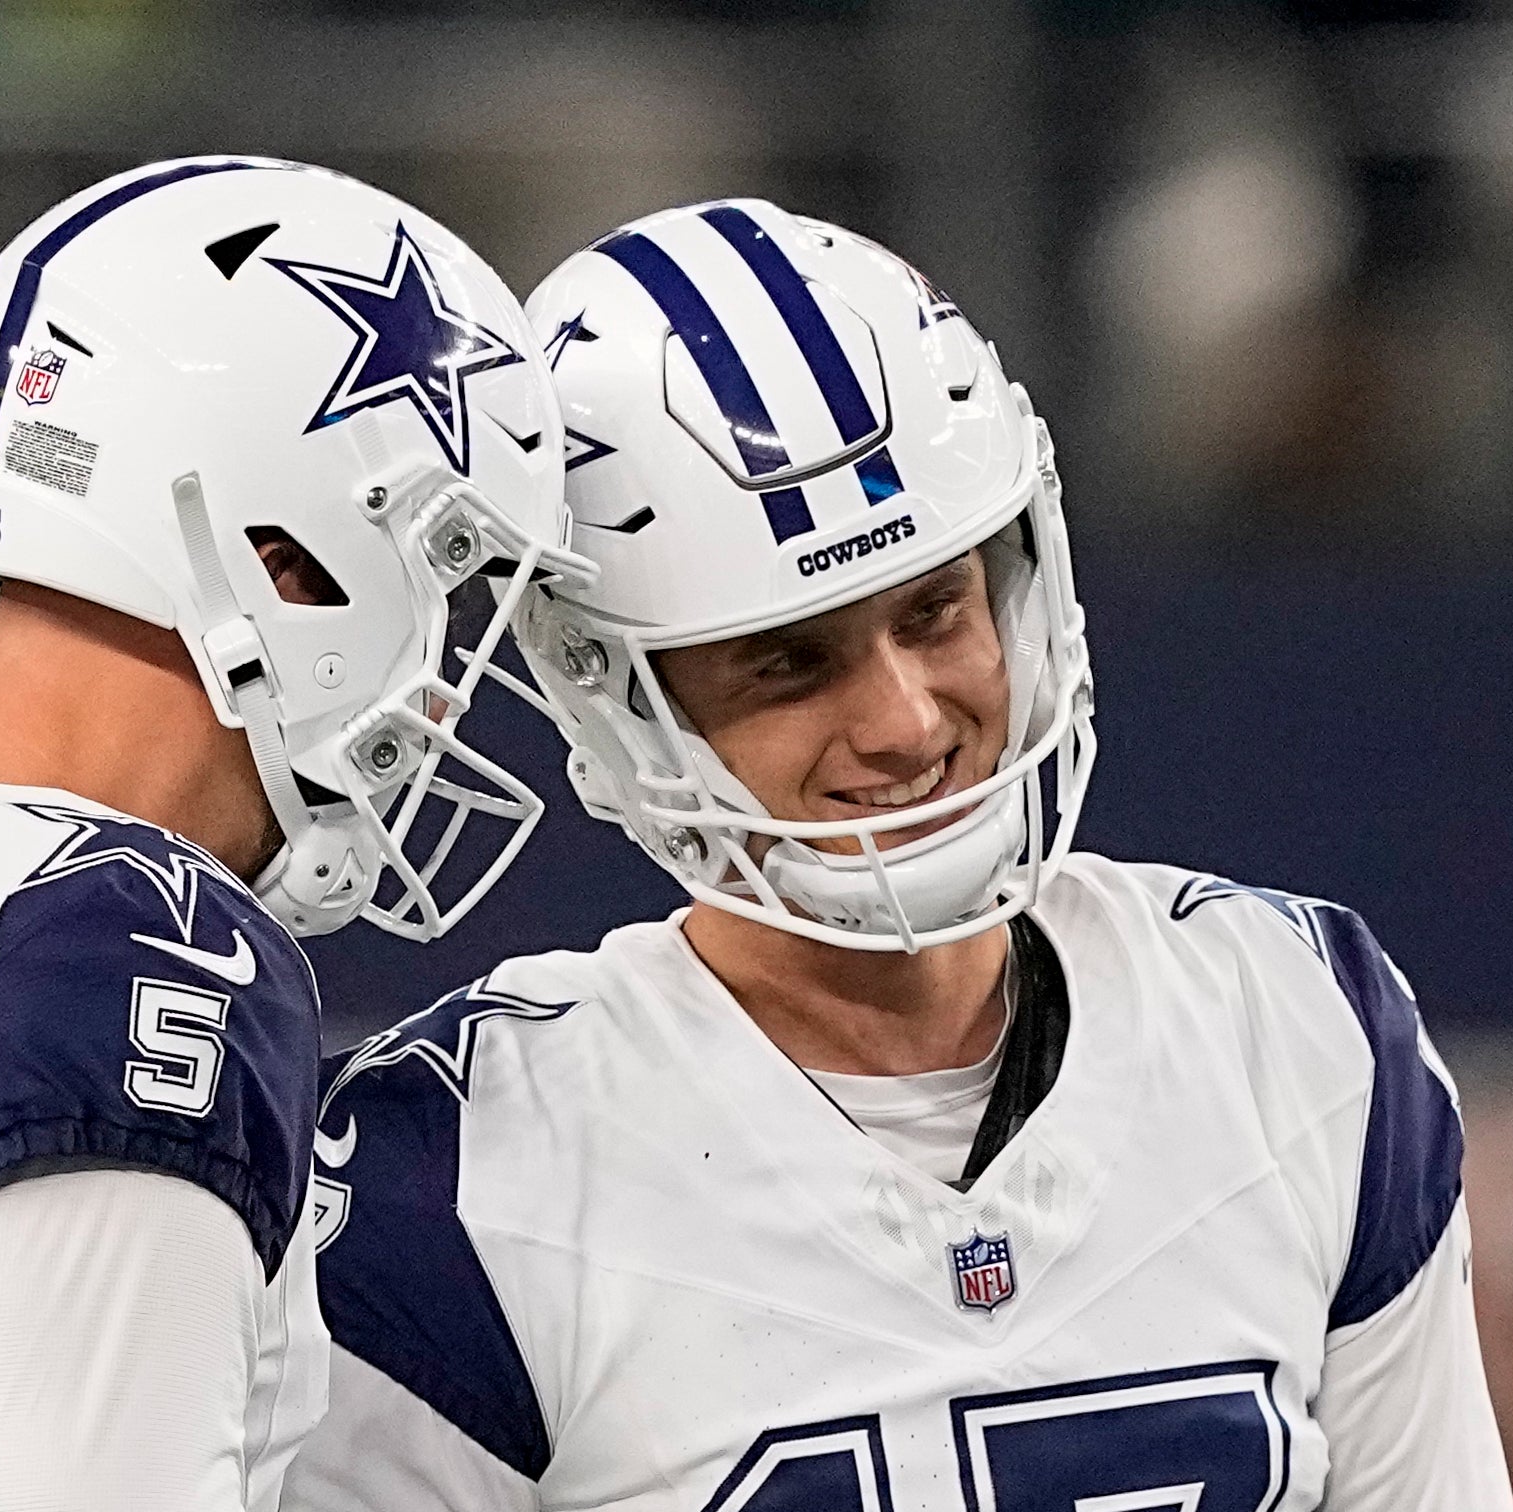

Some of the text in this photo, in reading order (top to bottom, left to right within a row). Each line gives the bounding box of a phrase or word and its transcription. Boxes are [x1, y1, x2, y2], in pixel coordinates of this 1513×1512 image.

[19, 368, 52, 399] NFL
[34, 421, 77, 437] WARNING
[797, 514, 917, 577] COWBOYS
[123, 976, 232, 1118] 5
[962, 1265, 1010, 1302] NFL
